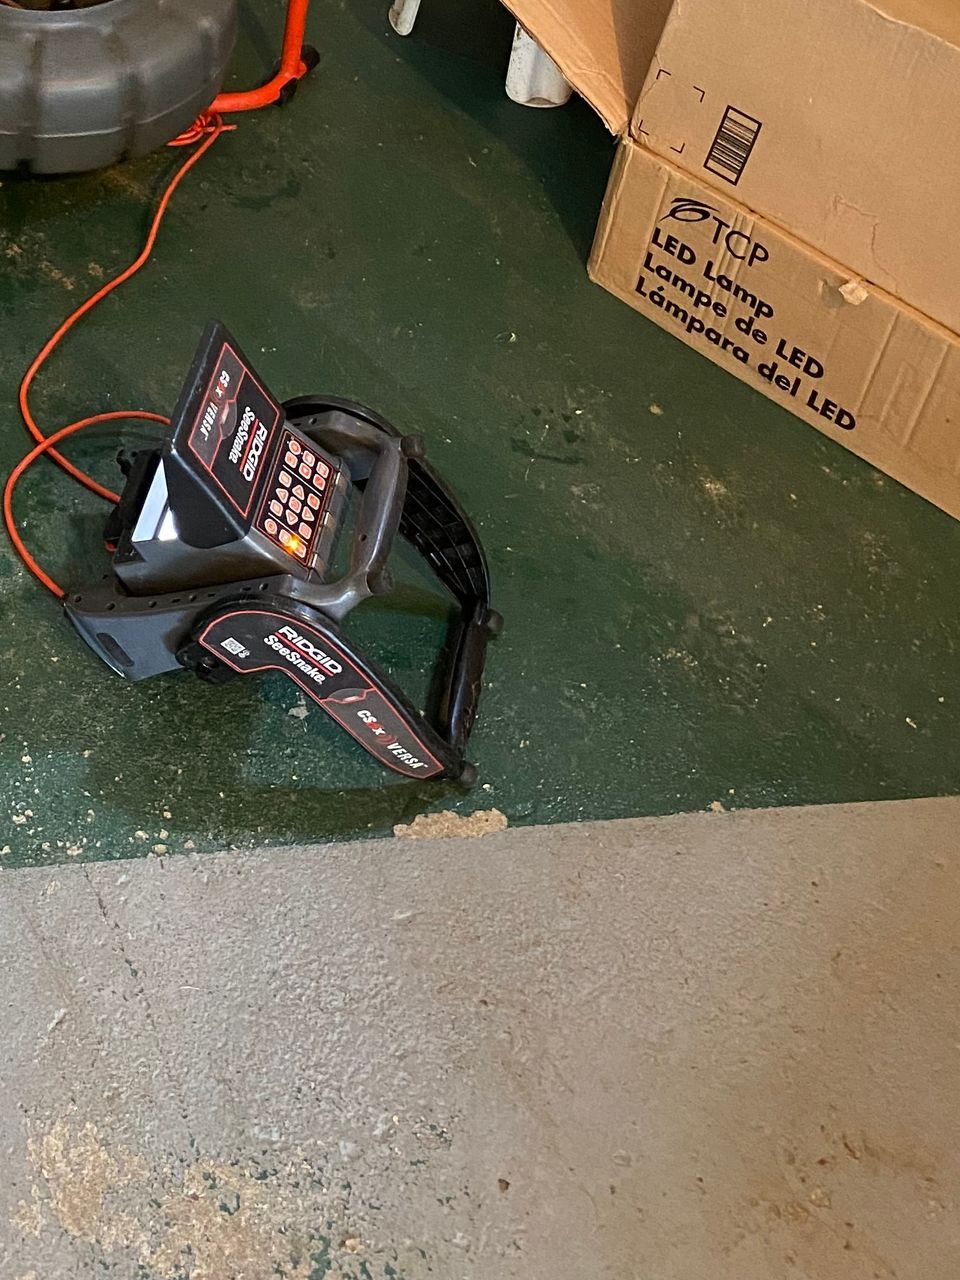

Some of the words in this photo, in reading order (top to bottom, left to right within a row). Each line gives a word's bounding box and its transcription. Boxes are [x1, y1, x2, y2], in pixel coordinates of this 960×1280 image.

[712, 215, 769, 267] TCP
[651, 227, 697, 266] LED
[703, 260, 774, 319] Lamp
[643, 251, 728, 320] Lampe
[735, 315, 768, 345] de
[775, 338, 825, 380] LED
[635, 275, 750, 365] Lámpara
[757, 361, 802, 397] del
[806, 389, 857, 432] LED
[228, 406, 256, 464] SeeSnake
[243, 422, 268, 482] RIDGID
[263, 634, 326, 685] SeeSnake
[277, 625, 343, 674] RIDGID
